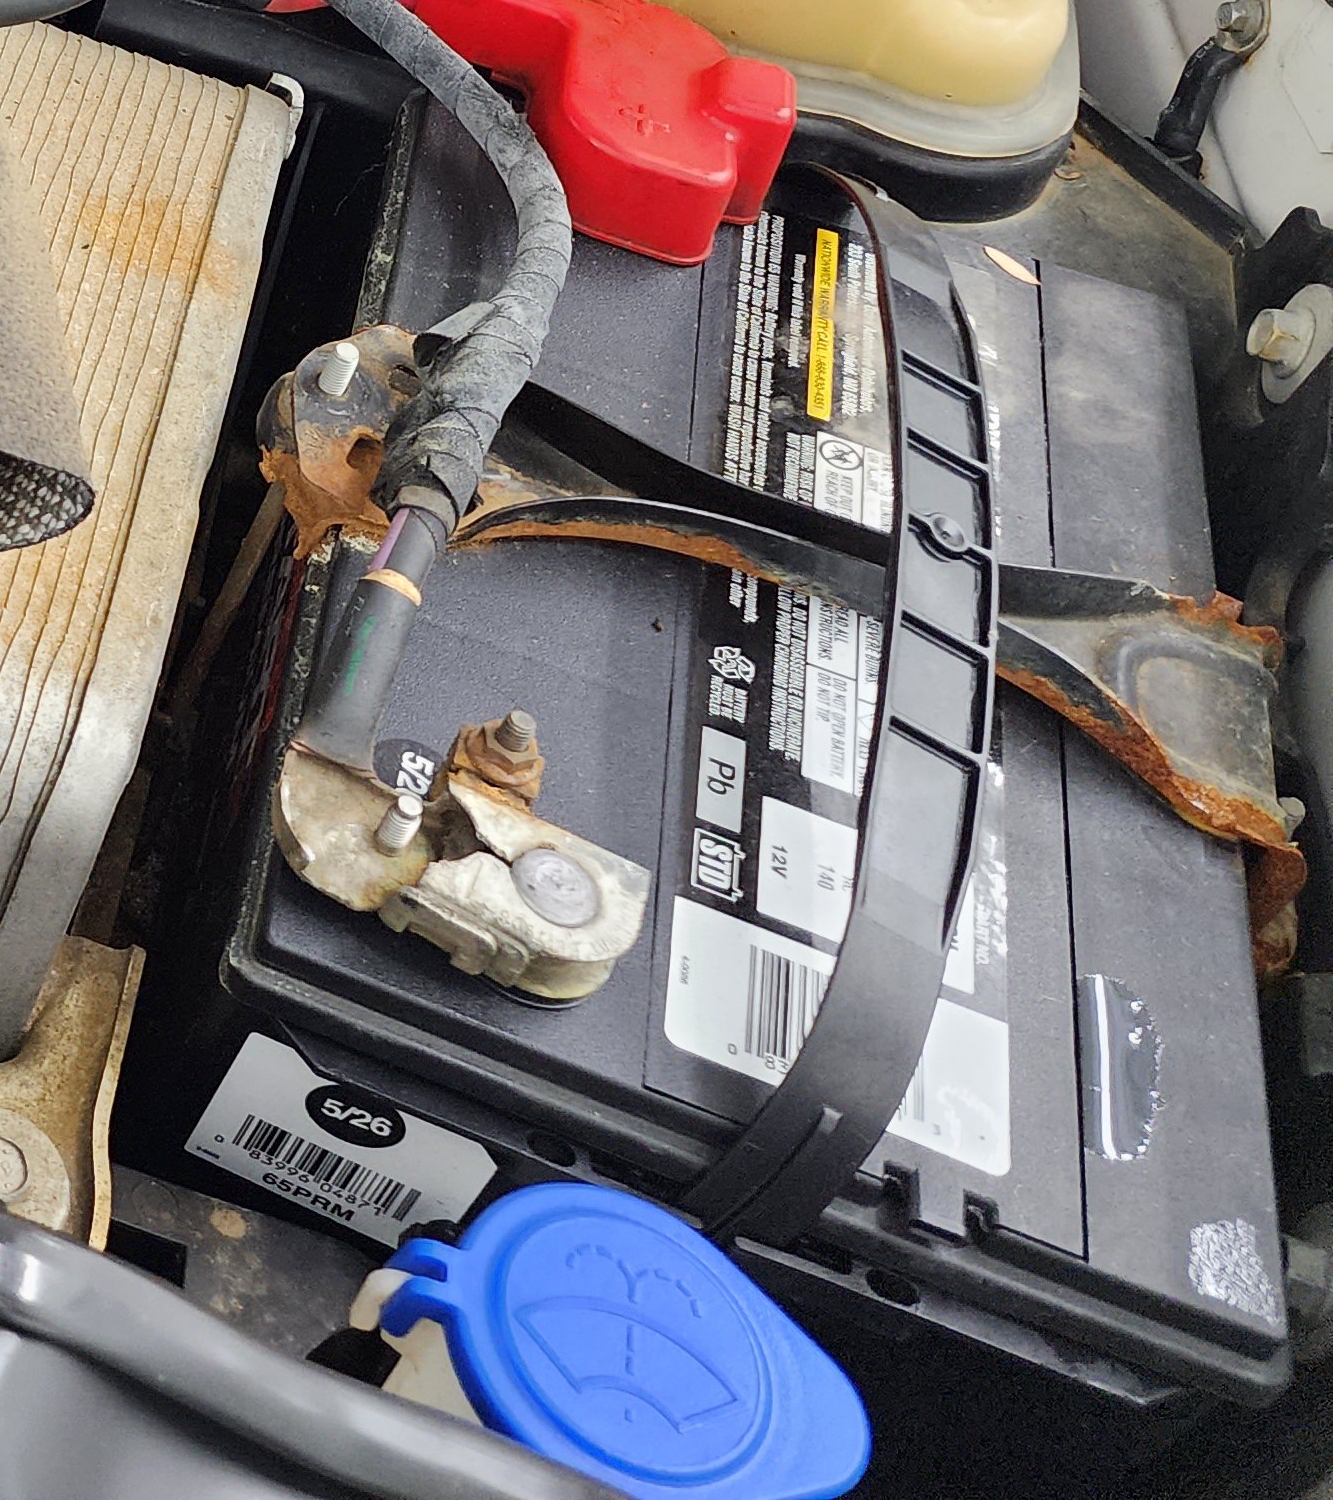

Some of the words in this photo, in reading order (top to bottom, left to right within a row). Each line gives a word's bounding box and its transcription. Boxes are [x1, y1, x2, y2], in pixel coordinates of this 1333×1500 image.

[768, 213, 783, 264] PROPOSITION
[767, 262, 780, 275] 65
[818, 238, 833, 286] NATIONWIDE
[737, 281, 751, 304] State
[751, 286, 765, 308] State
[765, 273, 780, 314] WARNING:
[733, 308, 749, 346] California
[748, 313, 762, 351] California
[761, 310, 777, 339] Battery
[760, 337, 773, 362] posts,
[816, 330, 827, 353] CALL
[744, 378, 756, 408] cancer
[759, 359, 773, 398] terminals
[727, 401, 742, 431] WASH
[742, 405, 755, 424] and
[758, 395, 772, 413] and
[756, 410, 771, 441] related
[724, 428, 740, 462] HANDS
[739, 420, 755, 472] reproductive
[785, 431, 801, 451] NOT
[798, 432, 816, 473] WARNING:
[753, 438, 768, 488] accessories
[782, 446, 800, 502] RECOMMENDE
[798, 469, 814, 491] RISK
[824, 469, 838, 497] REACH
[840, 474, 853, 496] KEEP
[824, 495, 837, 510] OF
[840, 494, 852, 512] OUT
[728, 582, 743, 609] other
[776, 585, 792, 612] LLOW
[774, 609, 791, 645] PROPER
[792, 606, 807, 622] DO
[834, 604, 849, 628] READ
[791, 619, 806, 640] NOT
[815, 600, 835, 661] NSTRUCTIONS.
[833, 627, 847, 645] ALL
[864, 619, 879, 654] SEVERE
[772, 642, 790, 689] CHARGING
[787, 637, 806, 697] DISASSEMBLE
[817, 671, 831, 688] DO
[708, 673, 723, 719] RECYCLED.
[721, 682, 734, 707] MUST
[816, 685, 830, 707] NOT
[833, 676, 847, 693] DO
[733, 686, 747, 724] BATTERY
[787, 694, 803, 710] OR
[815, 705, 829, 725] TIP.
[832, 691, 847, 713] NOT
[767, 686, 788, 754] INSTRUCTIONS.
[831, 710, 846, 737] OPEN
[784, 707, 802, 764] INCINERATE.
[828, 736, 846, 780] BATTERY.
[395, 751, 435, 800] 5/2
[705, 756, 737, 800] Pb
[696, 835, 733, 892] STD
[769, 842, 789, 879] 12V
[816, 863, 836, 892] 140
[318, 1093, 395, 1140] 5/26
[212, 1132, 225, 1145] 0
[245, 1147, 313, 1185] 83996
[317, 1179, 385, 1217] 04871
[258, 1169, 358, 1223] 65PRM
